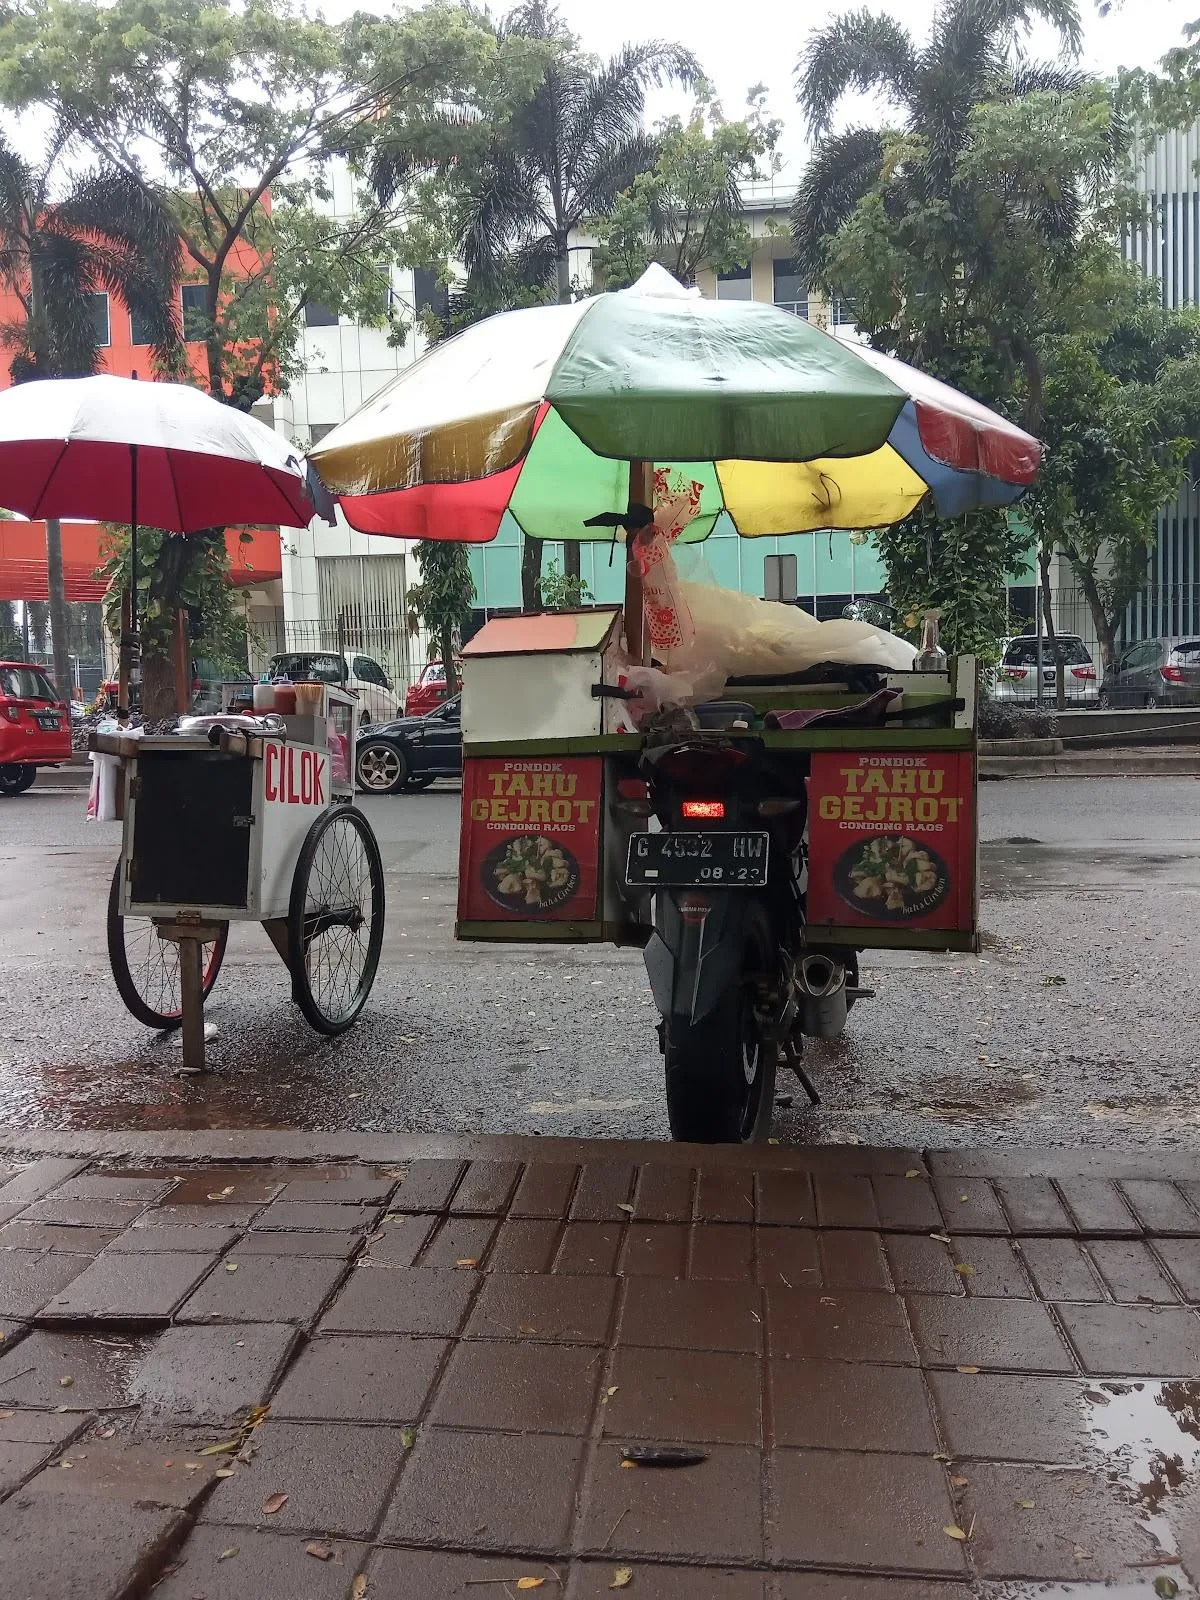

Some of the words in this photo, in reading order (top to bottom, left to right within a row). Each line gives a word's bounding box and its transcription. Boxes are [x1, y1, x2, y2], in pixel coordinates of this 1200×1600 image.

[504, 763, 562, 772] PONDOK
[859, 757, 928, 767] PONDOK
[265, 743, 325, 805] CILOK
[840, 769, 945, 794] TAHU
[488, 774, 578, 796] TAHU
[471, 799, 595, 823] GEJROT
[819, 796, 964, 822] GEJROT
[486, 822, 541, 831] CONDONG
[543, 823, 576, 832] RAOS
[839, 822, 903, 832] CONDONG
[905, 823, 944, 832] RAOS
[637, 837, 649, 857] G
[733, 837, 763, 857] HW
